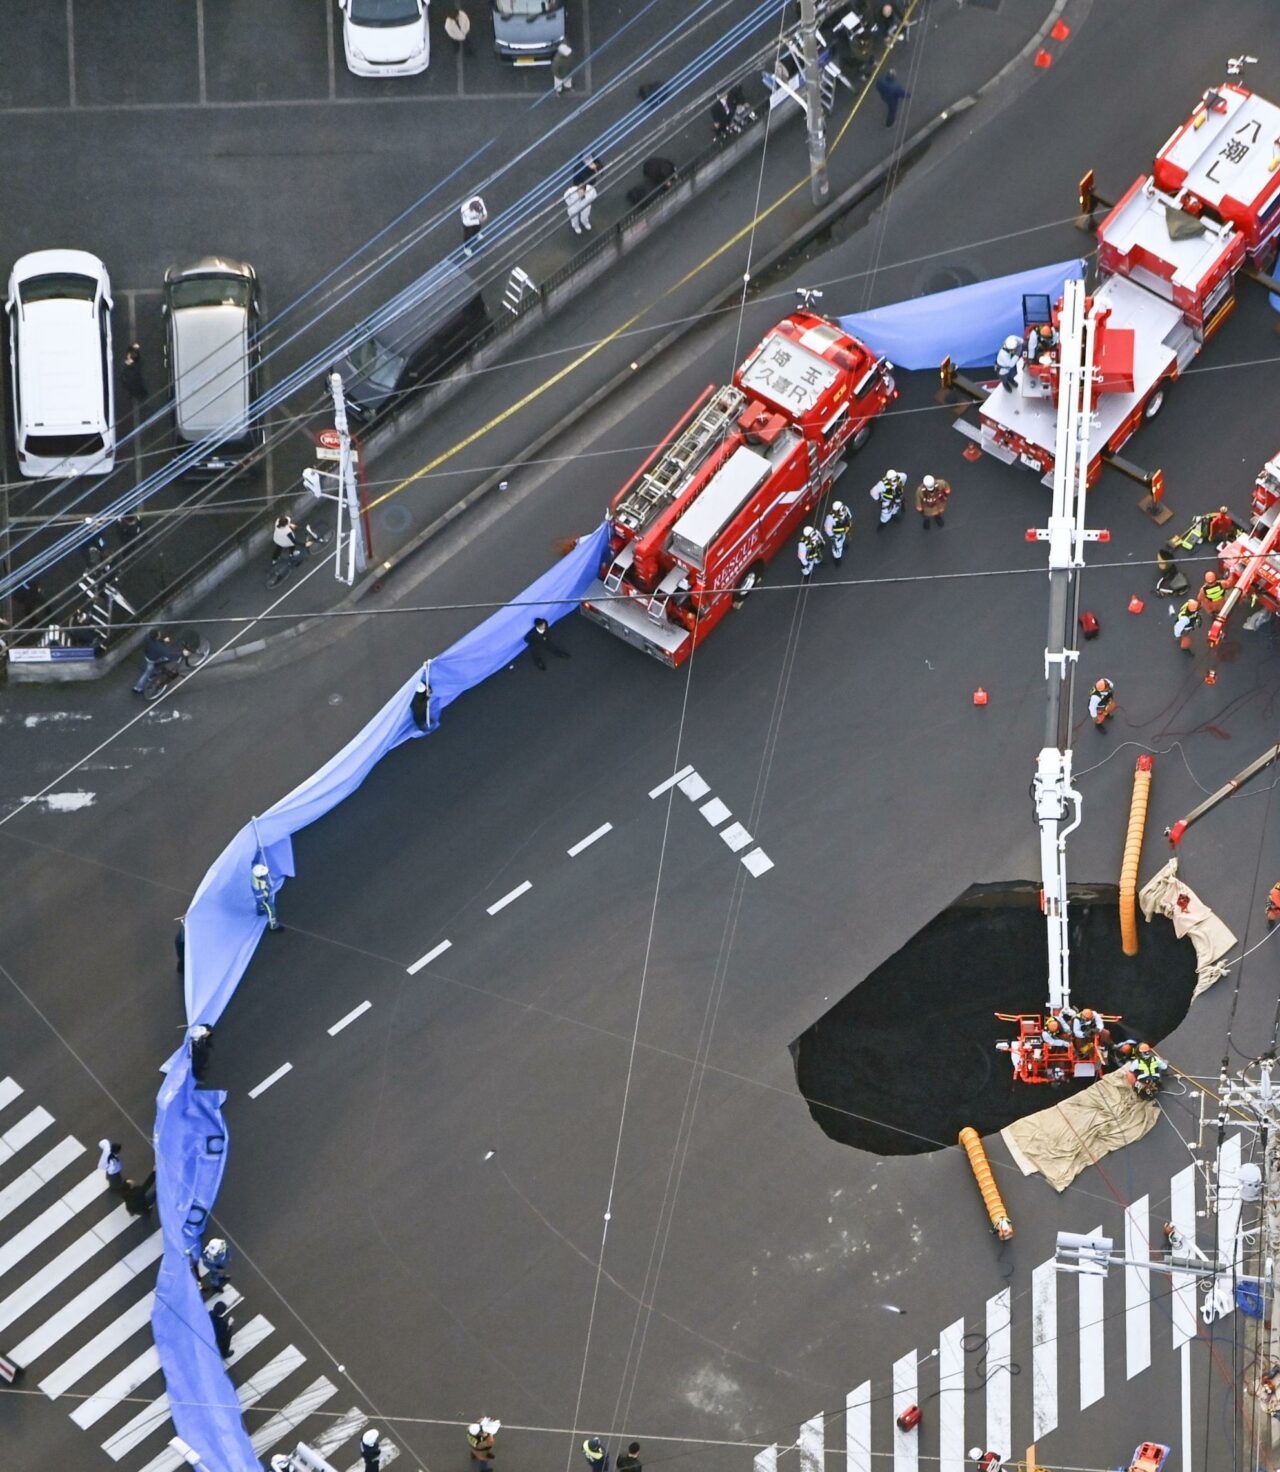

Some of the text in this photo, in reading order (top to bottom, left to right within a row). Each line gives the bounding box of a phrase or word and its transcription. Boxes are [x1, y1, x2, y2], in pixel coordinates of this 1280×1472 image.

[1205, 119, 1262, 184] 八潮L
[754, 366, 809, 405] 久喜R
[770, 348, 823, 386] 埼玉
[712, 527, 761, 592] RESCUE
